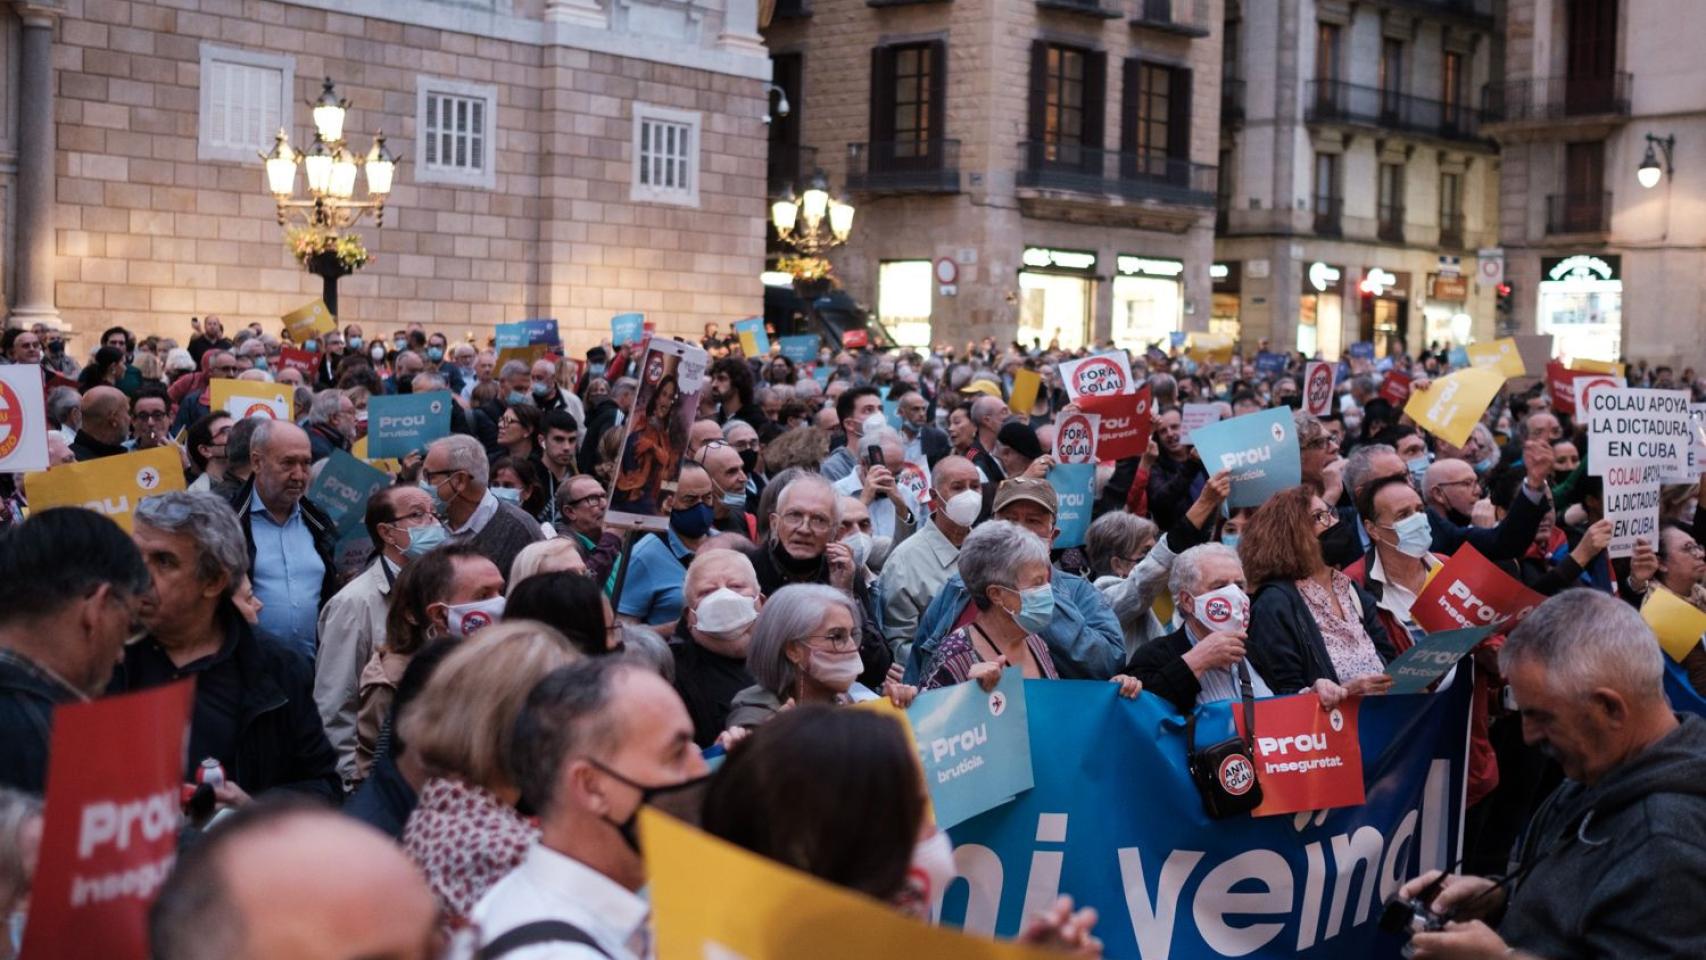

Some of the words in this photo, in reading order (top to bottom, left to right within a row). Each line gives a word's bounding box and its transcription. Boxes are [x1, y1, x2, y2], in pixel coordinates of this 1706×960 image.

[1080, 366, 1117, 381] FORA
[1080, 379, 1123, 395] COLAU
[1594, 394, 1645, 412] COLAU
[1648, 396, 1688, 414] APOYA
[1063, 428, 1089, 440] FORA
[1592, 417, 1613, 434] LA
[1617, 418, 1689, 437] DICTADURA
[1059, 444, 1092, 456] COLAU
[1608, 440, 1633, 458] EN
[1637, 441, 1677, 459] CUBA
[1608, 466, 1641, 487] COLAU
[1642, 464, 1660, 484] APOY
[1608, 495, 1621, 513] LA
[1613, 519, 1629, 538] EN
[1631, 516, 1655, 537] CUBA
[931, 722, 987, 763] Prou
[1257, 732, 1328, 757] Prou
[1226, 760, 1248, 778] ANTI
[1224, 772, 1253, 788] COLAU
